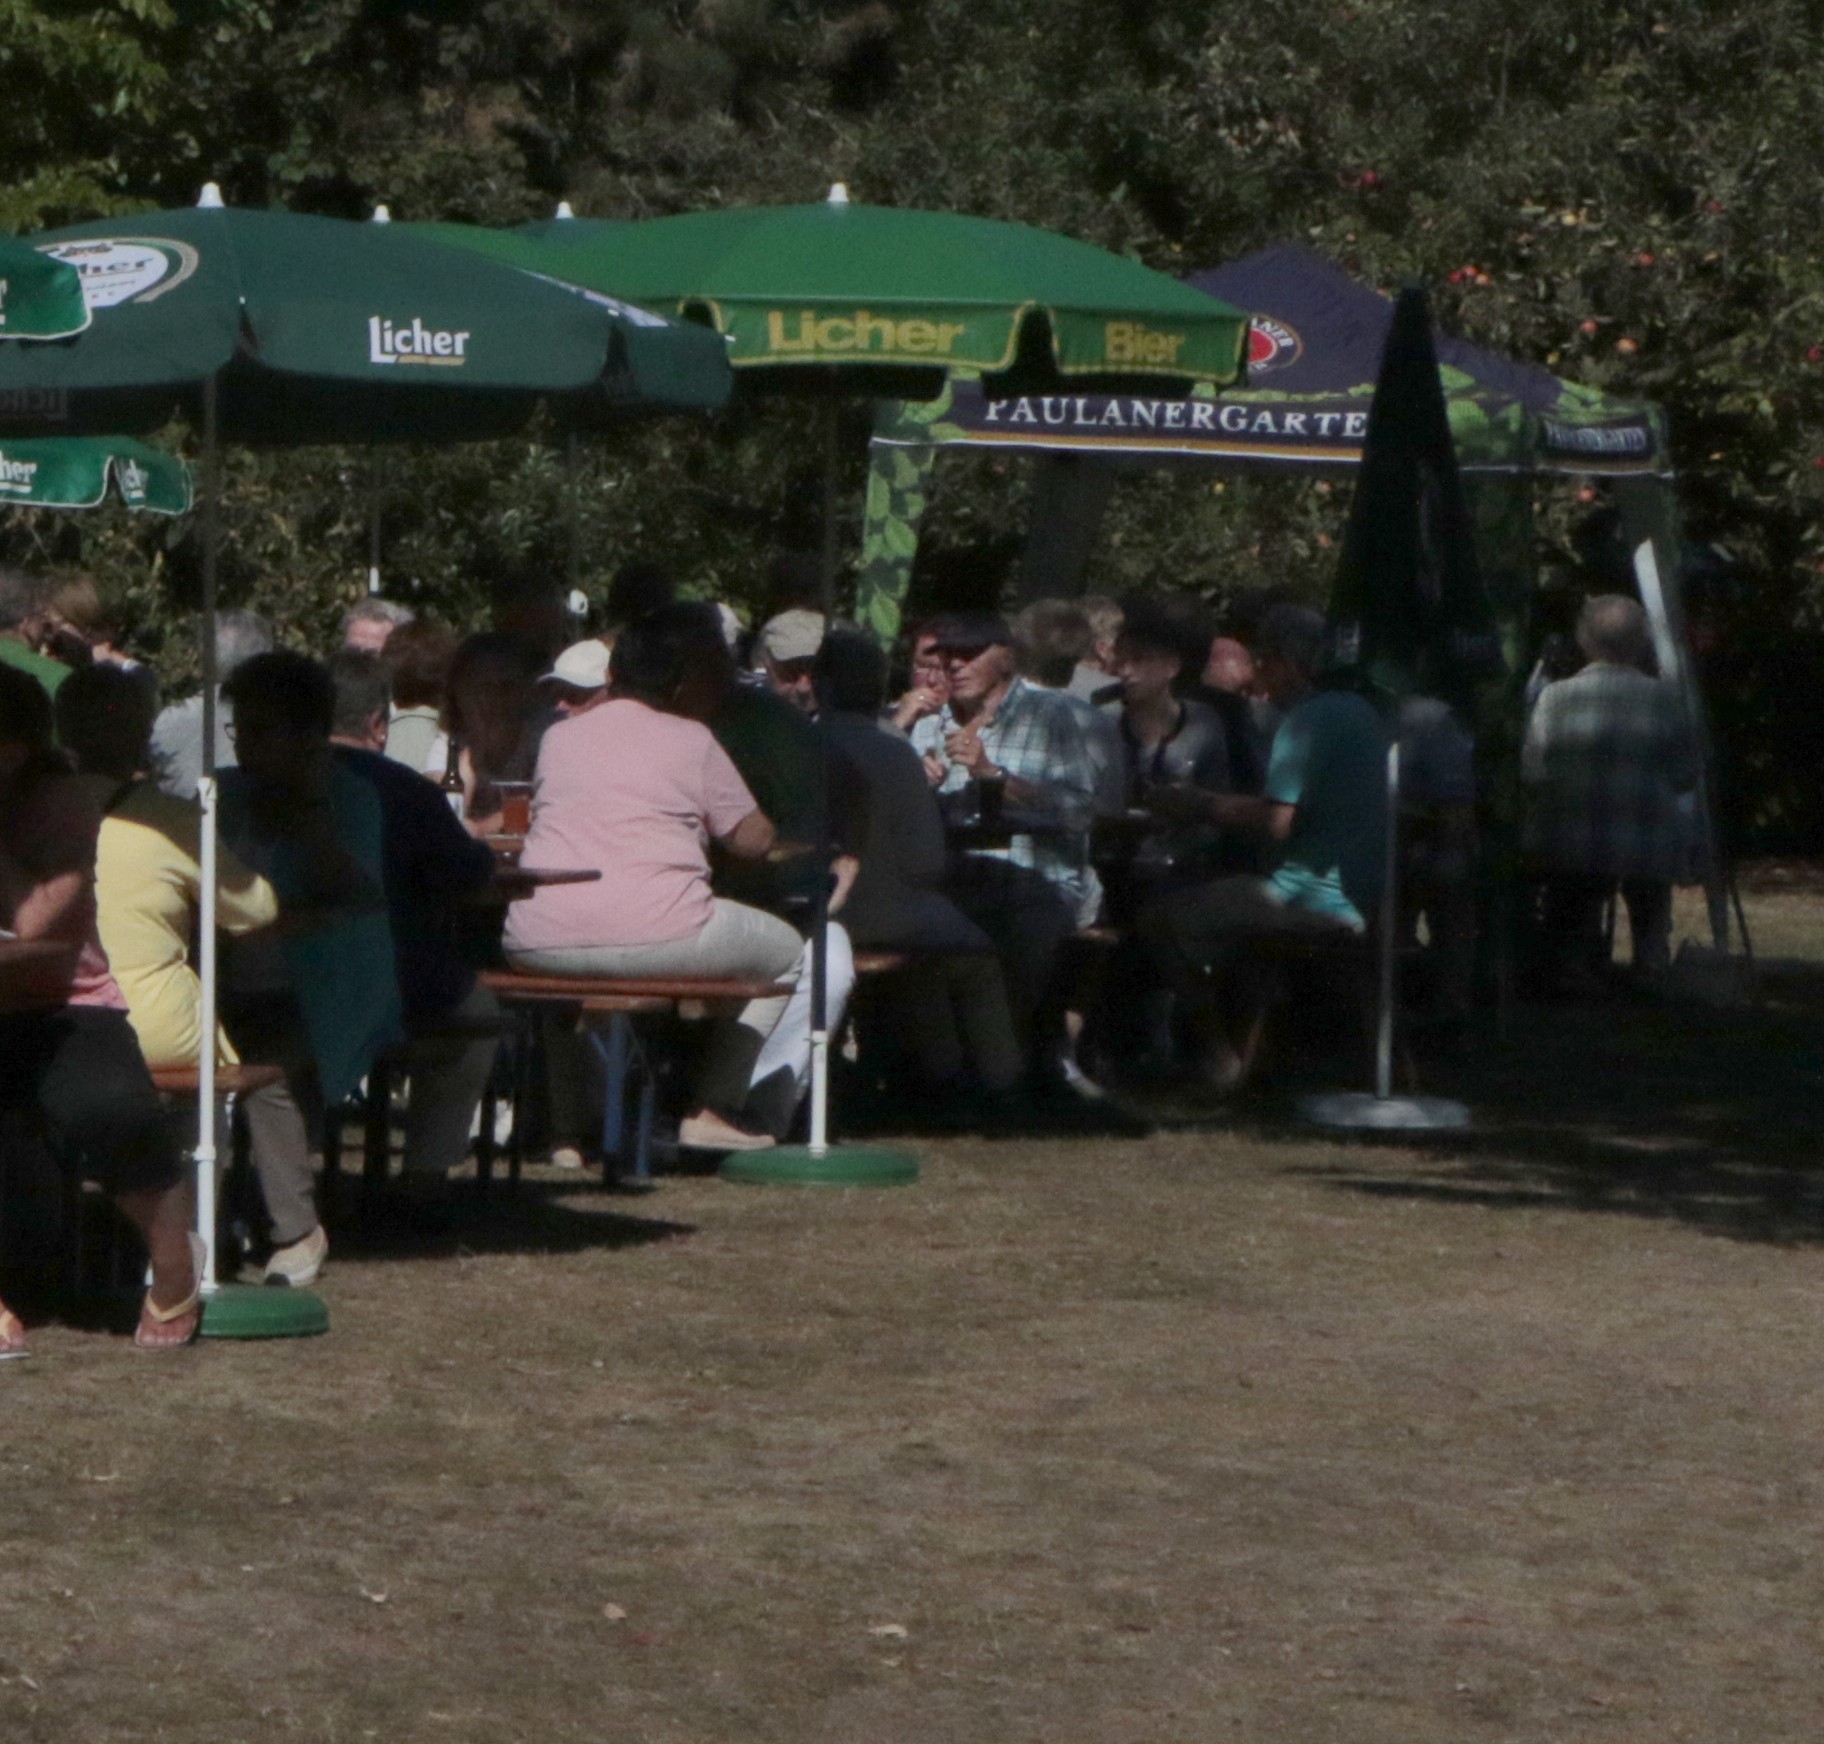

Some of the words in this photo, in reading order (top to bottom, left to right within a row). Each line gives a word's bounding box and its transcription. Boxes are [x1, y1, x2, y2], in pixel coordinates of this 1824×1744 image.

[368, 315, 471, 367] Licher
[767, 310, 965, 352] Licher
[1103, 320, 1186, 363] Bier
[984, 396, 1368, 438] PAULANERGARTE
